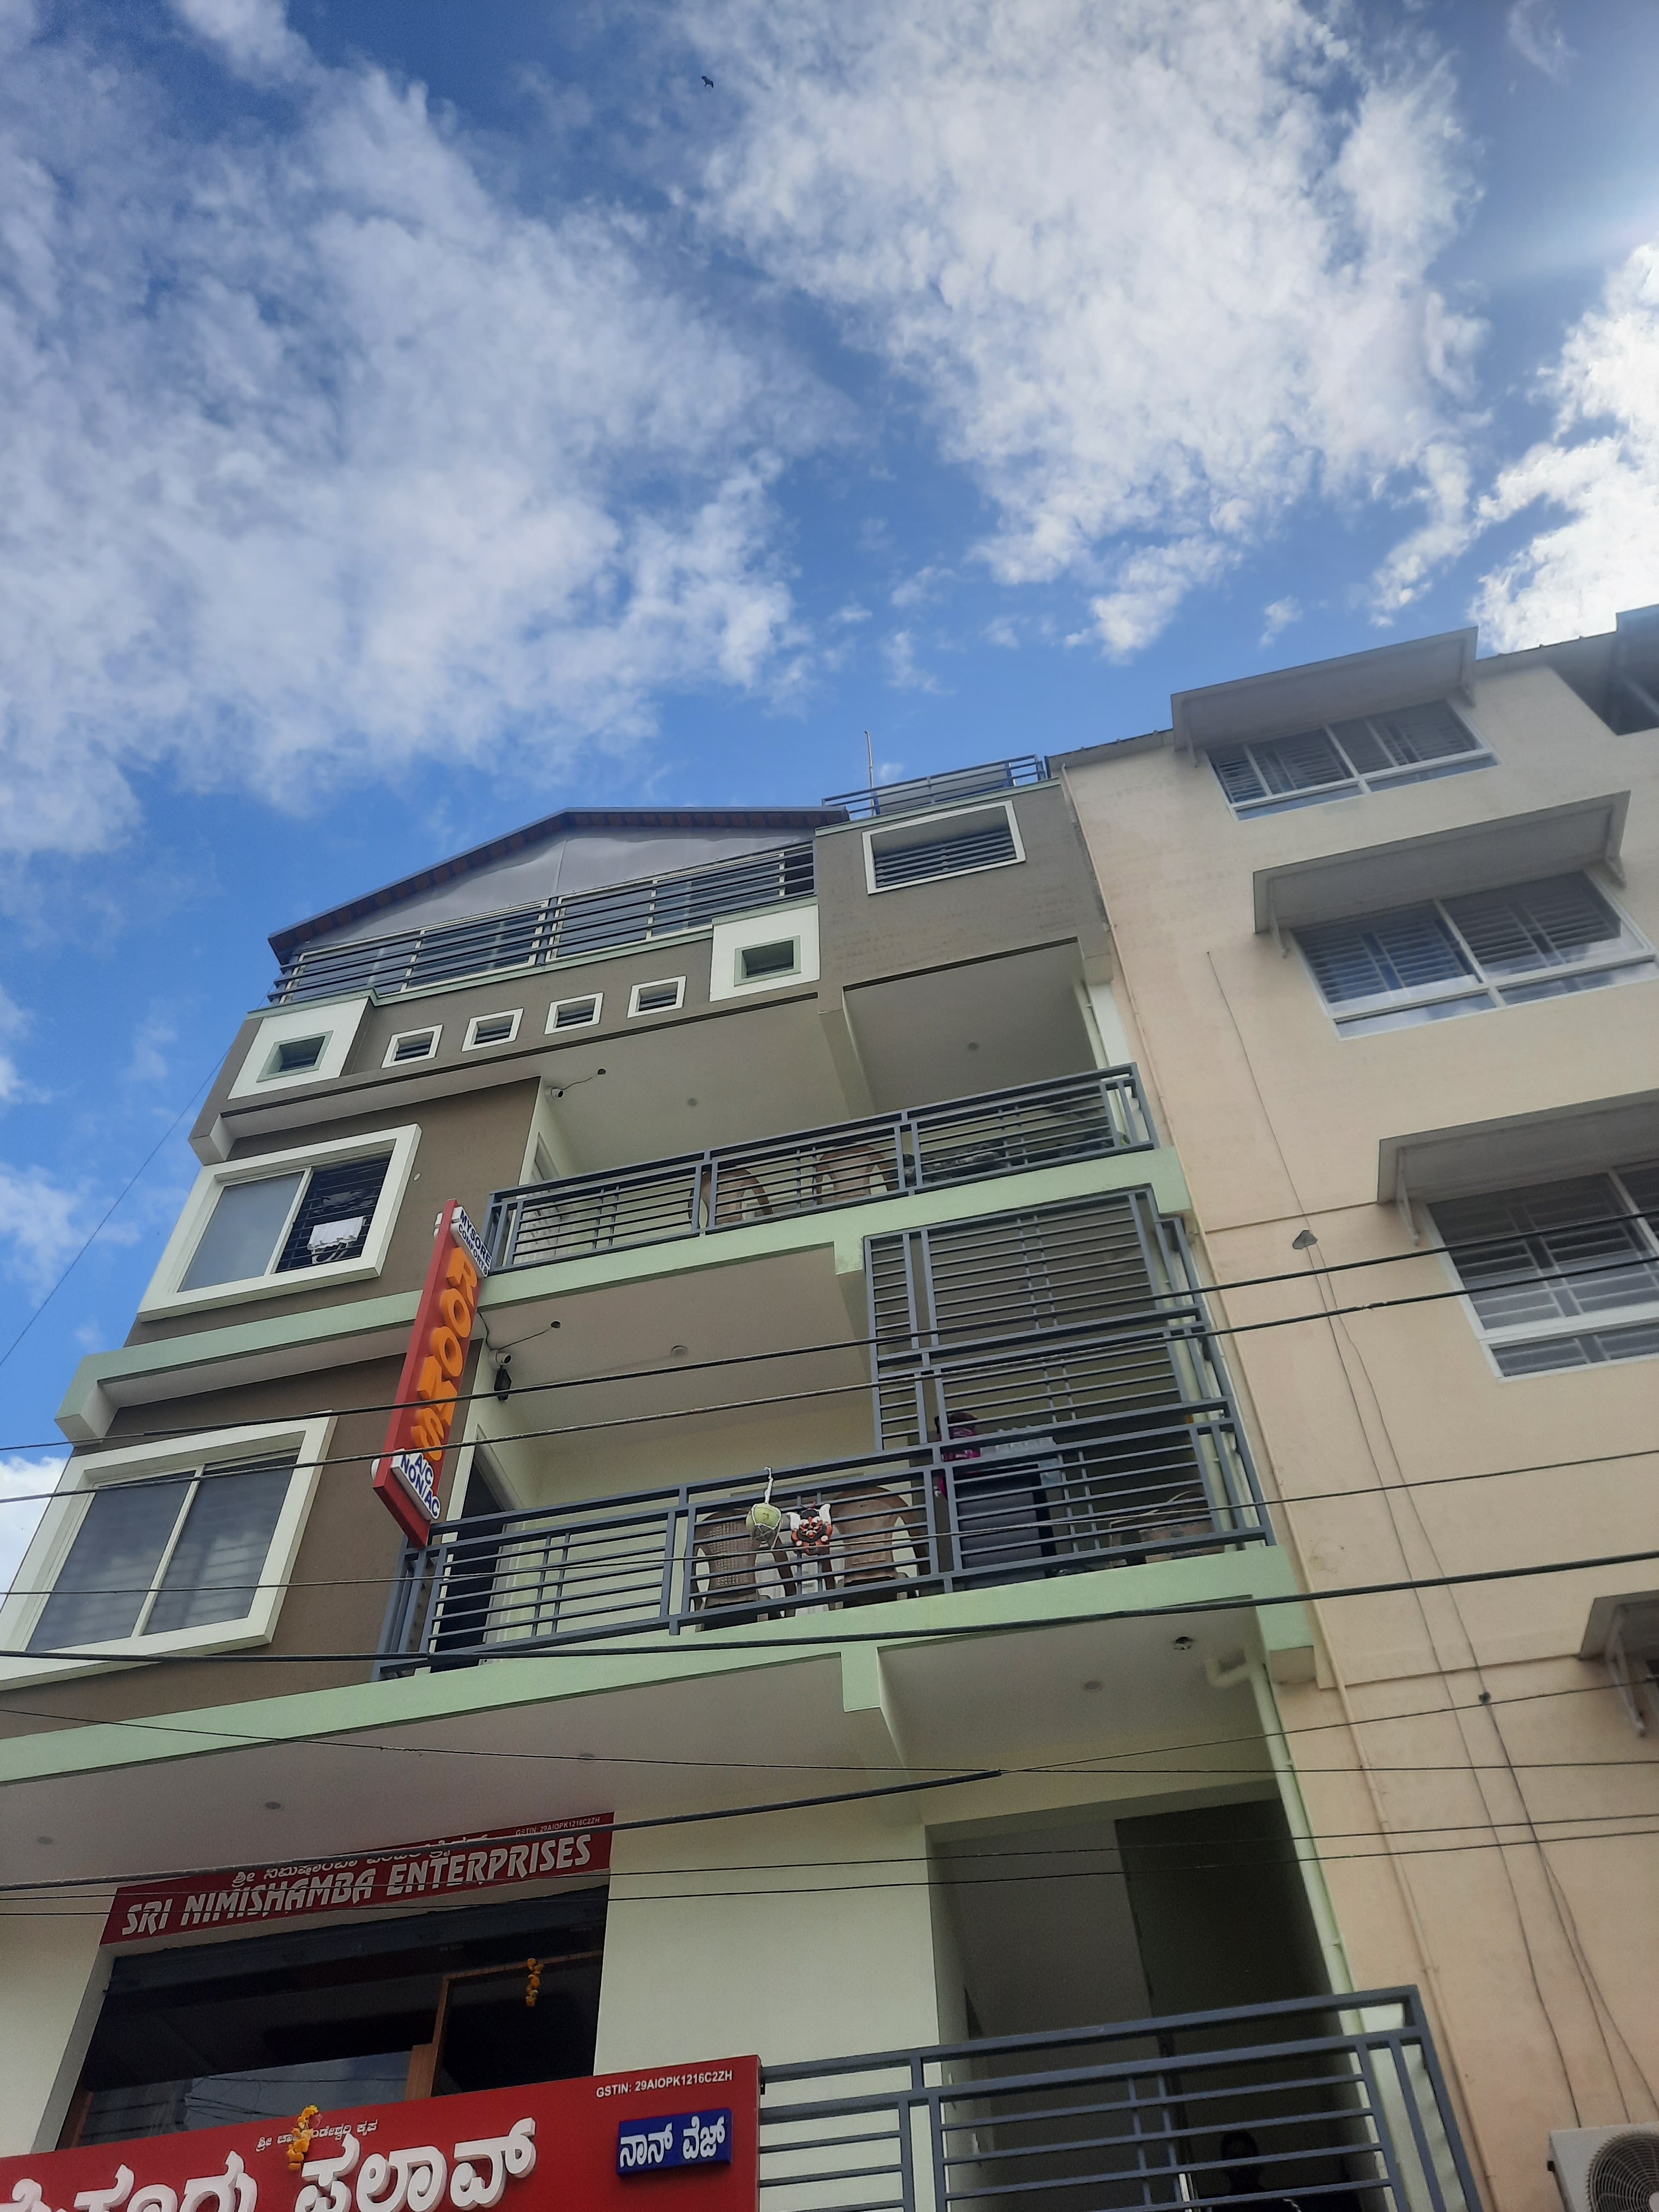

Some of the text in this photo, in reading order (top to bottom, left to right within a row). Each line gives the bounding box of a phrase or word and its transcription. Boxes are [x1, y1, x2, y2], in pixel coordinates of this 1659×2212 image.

[458, 1223, 488, 1276] COMFORTS
[460, 1209, 492, 1267] MYSORE
[411, 1245, 478, 1461] ROOMS
[414, 1453, 433, 1485] A/C
[122, 1898, 173, 1936] SRI
[180, 1869, 376, 1926] NIMISHAMBA
[387, 1834, 591, 1896] ENTERPRISES
[231, 1871, 255, 1888] ಶ್ರೀ
[596, 2069, 733, 2098] GSTIN: 29AIOPK1216C2ZH
[255, 2135, 273, 2153] ಶ್ರೀ
[295, 2117, 537, 2212] ಪಲಾವ್
[619, 2115, 726, 2168] ನಾನ್ ವೆಜ್
